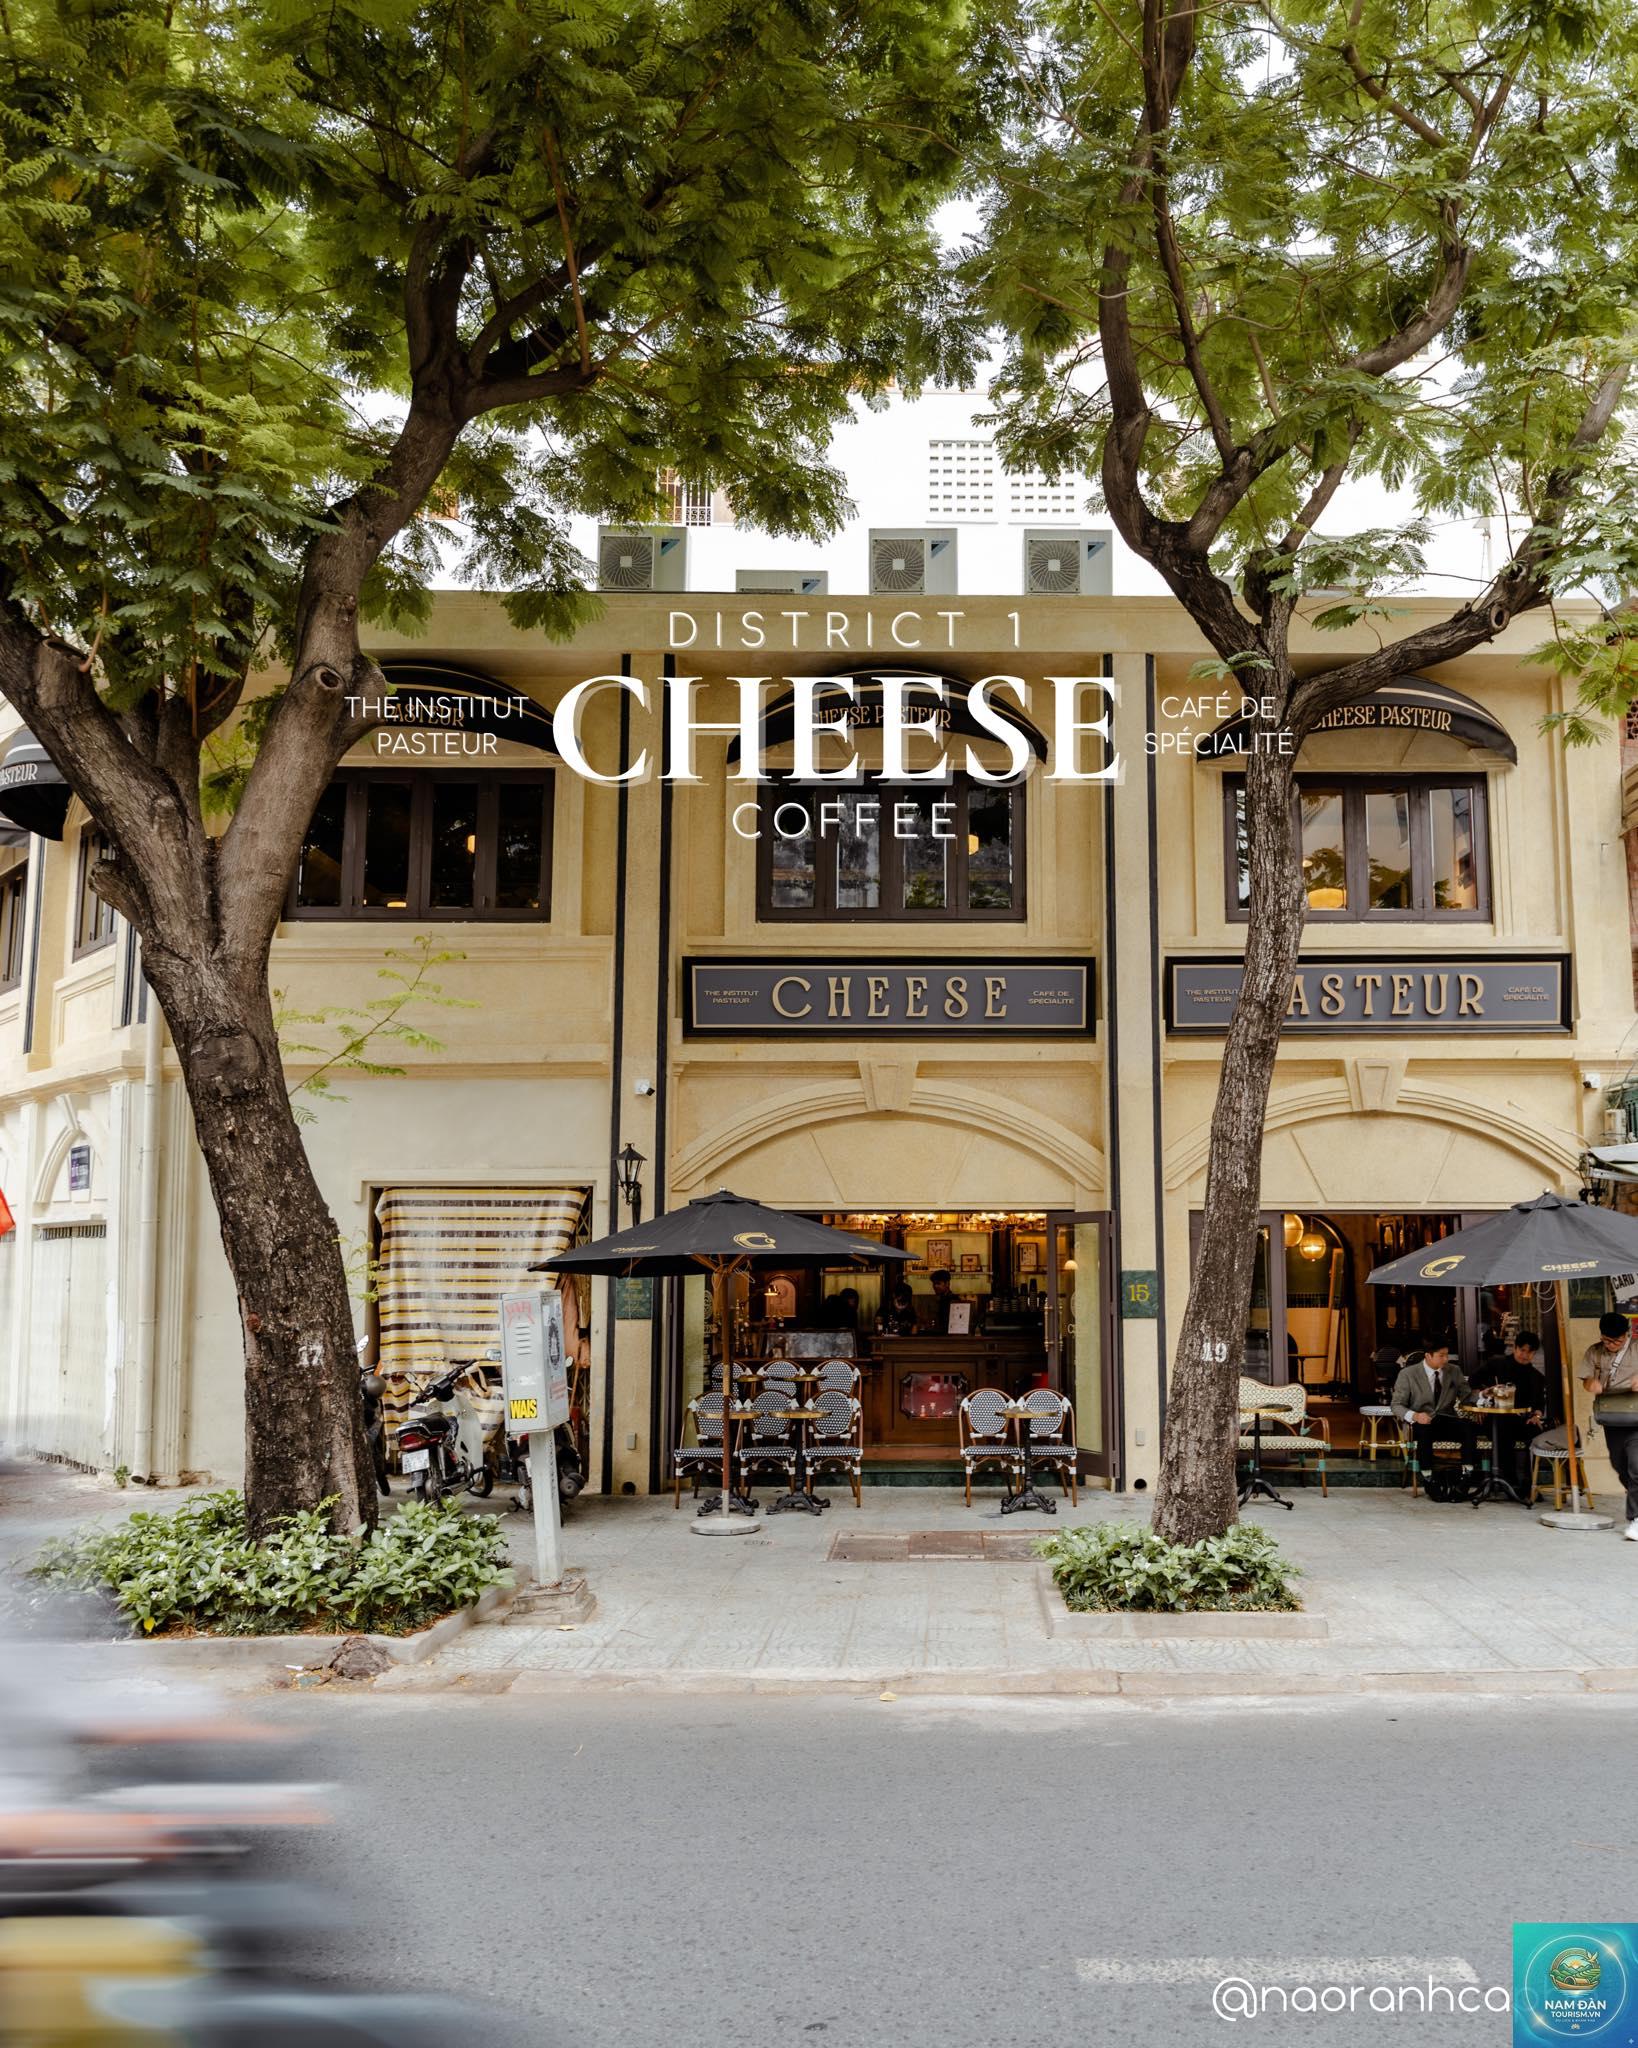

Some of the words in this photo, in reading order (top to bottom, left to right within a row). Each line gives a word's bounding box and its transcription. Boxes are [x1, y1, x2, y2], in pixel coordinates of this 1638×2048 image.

[812, 706, 870, 726] HEESE
[875, 705, 951, 729] PSTEUR
[1310, 706, 1375, 730] HEESE
[1381, 706, 1452, 731] PASTEUR
[772, 976, 1008, 1018] CHEESE
[1286, 973, 1485, 1017] ASTEUR
[1611, 1273, 1635, 1290] CARD
[1128, 1284, 1151, 1302] 15
[1201, 1342, 1227, 1363] 19
[511, 1399, 537, 1419] WAIS
